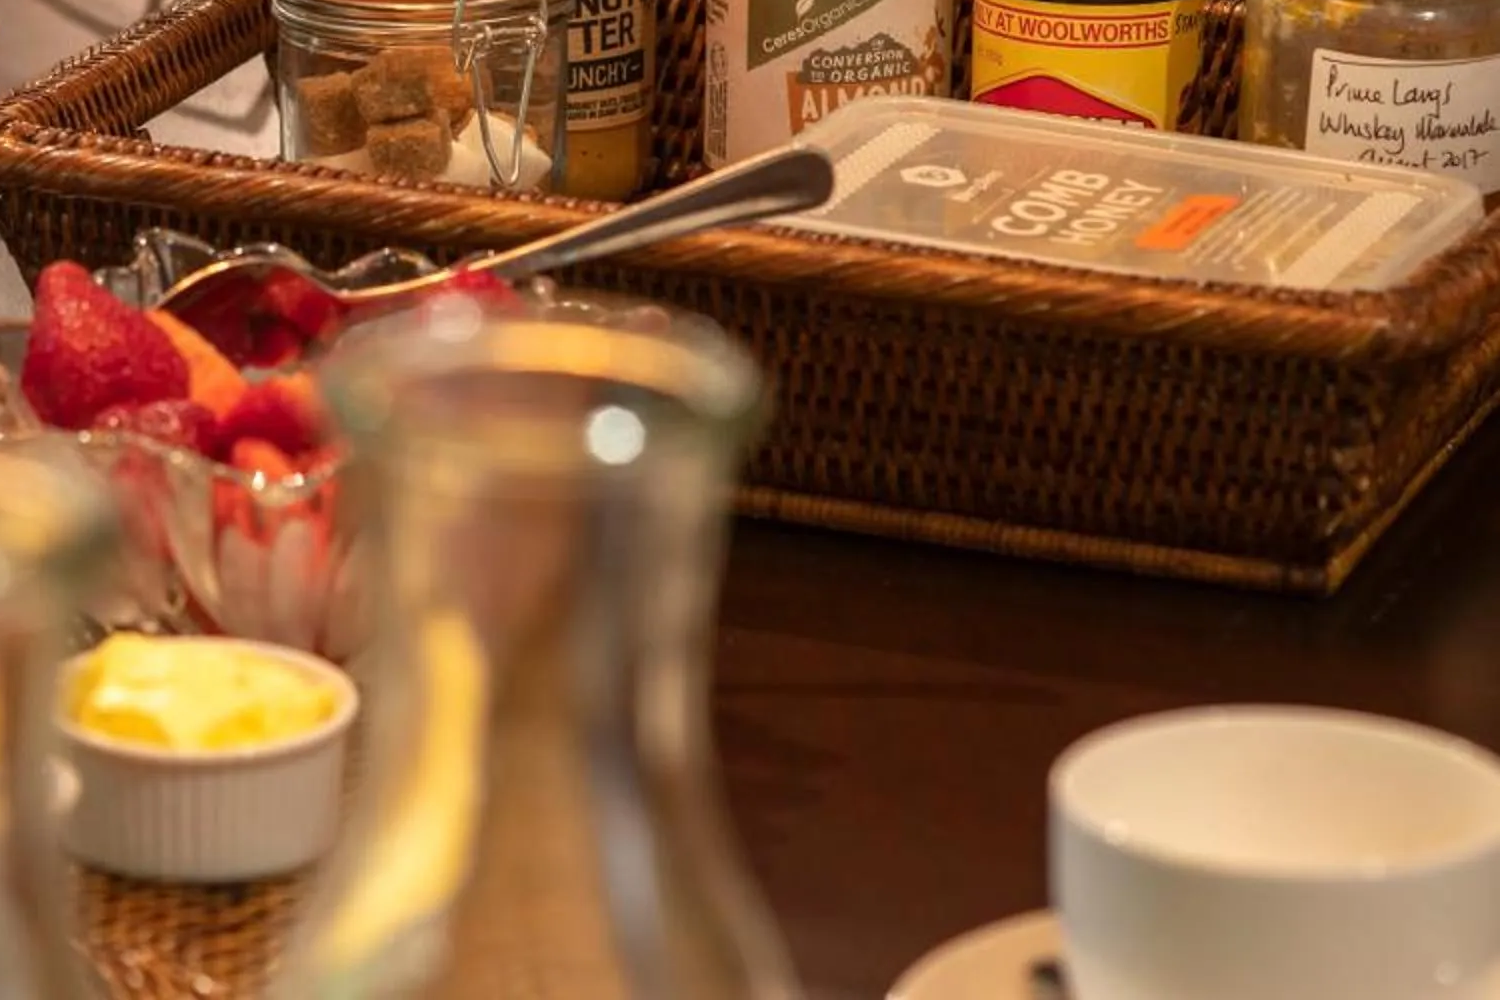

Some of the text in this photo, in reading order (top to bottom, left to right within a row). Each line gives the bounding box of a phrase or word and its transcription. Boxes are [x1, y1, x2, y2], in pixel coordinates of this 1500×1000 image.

[996, 11, 1015, 33] AT
[1017, 15, 1169, 42] WOOLWORTHS
[811, 50, 904, 68] CONVERSION
[830, 61, 912, 83] ORGANIC
[1442, 148, 1490, 170] 2017
[991, 169, 1109, 236] COMB
[1048, 178, 1164, 246] HONEY
